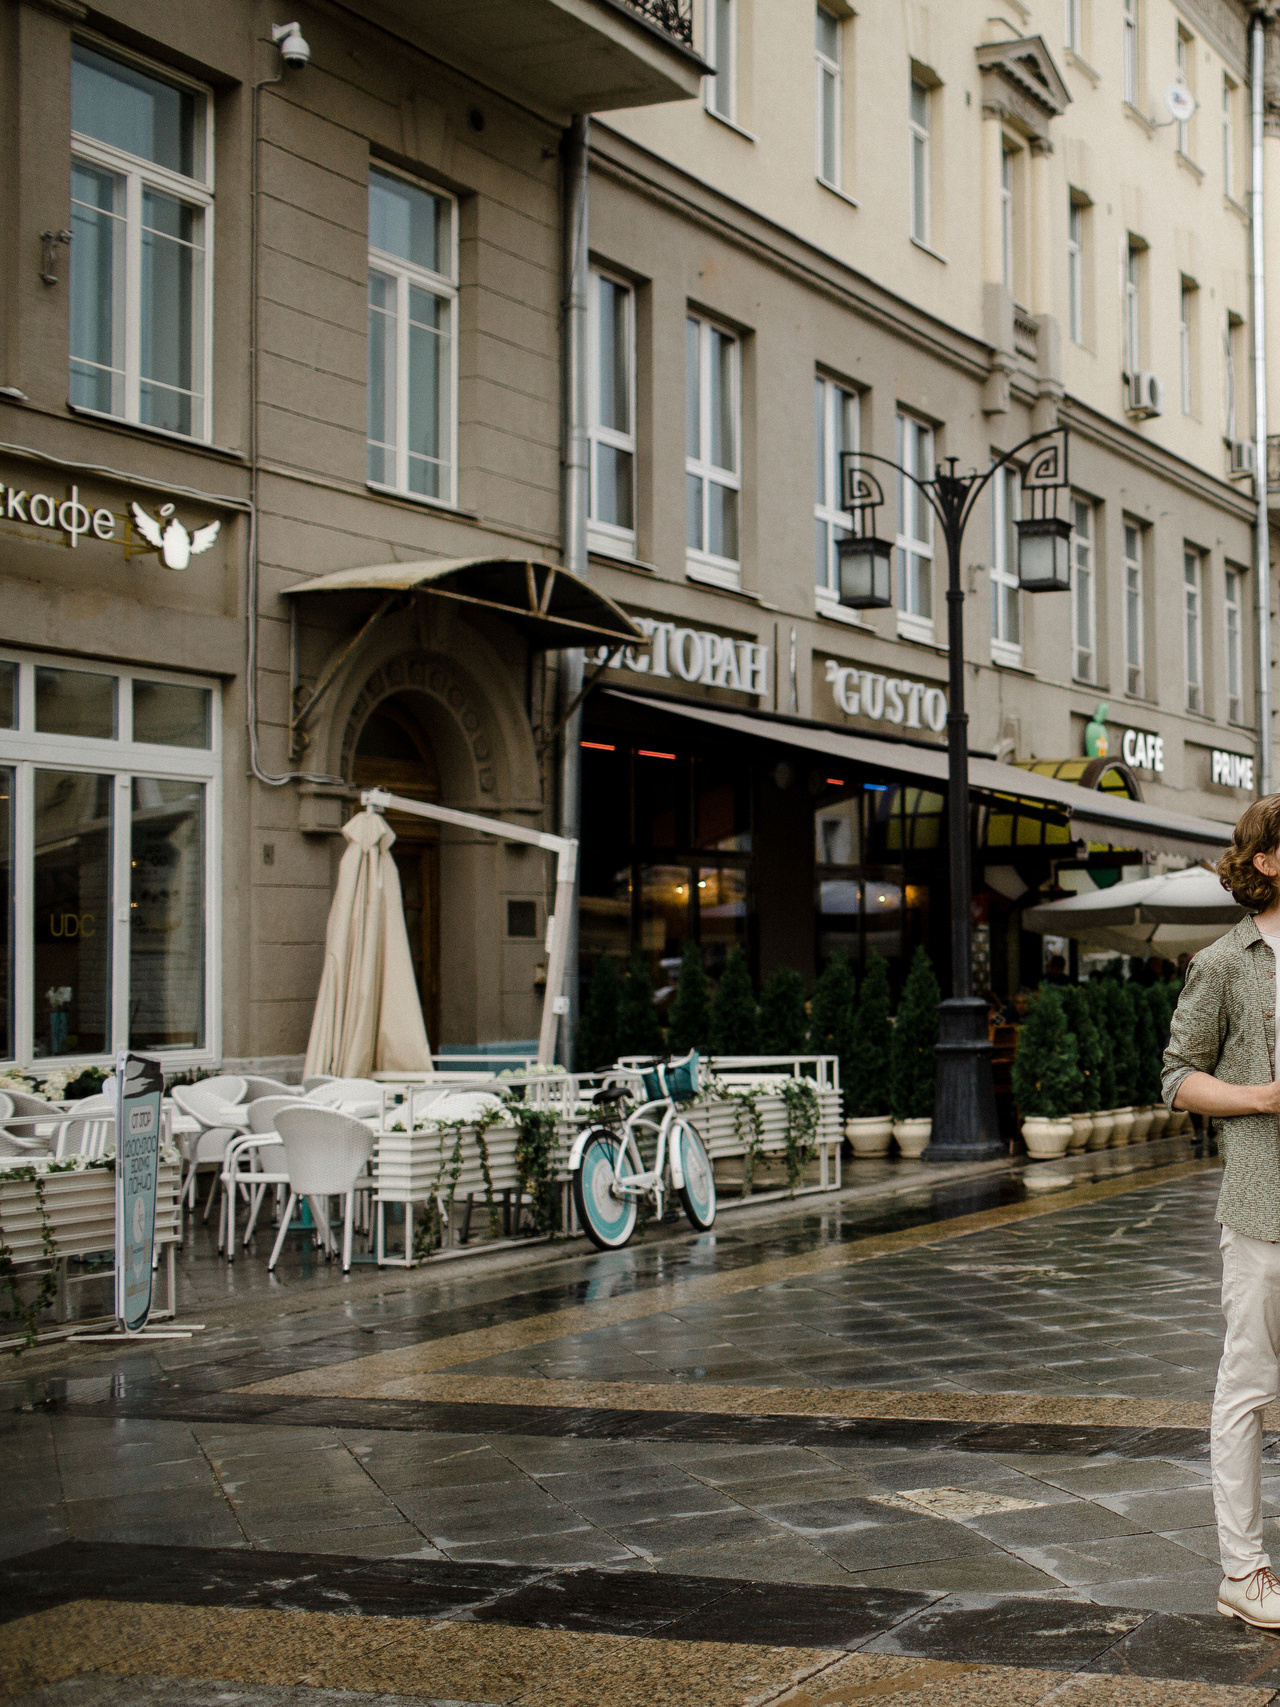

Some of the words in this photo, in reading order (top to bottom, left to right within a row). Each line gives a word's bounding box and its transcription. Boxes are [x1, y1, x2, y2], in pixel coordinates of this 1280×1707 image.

[0, 482, 116, 548] кафе
[1122, 729, 1165, 773] CAFE
[1211, 750, 1254, 791] PRIME
[50, 913, 95, 937] UDC
